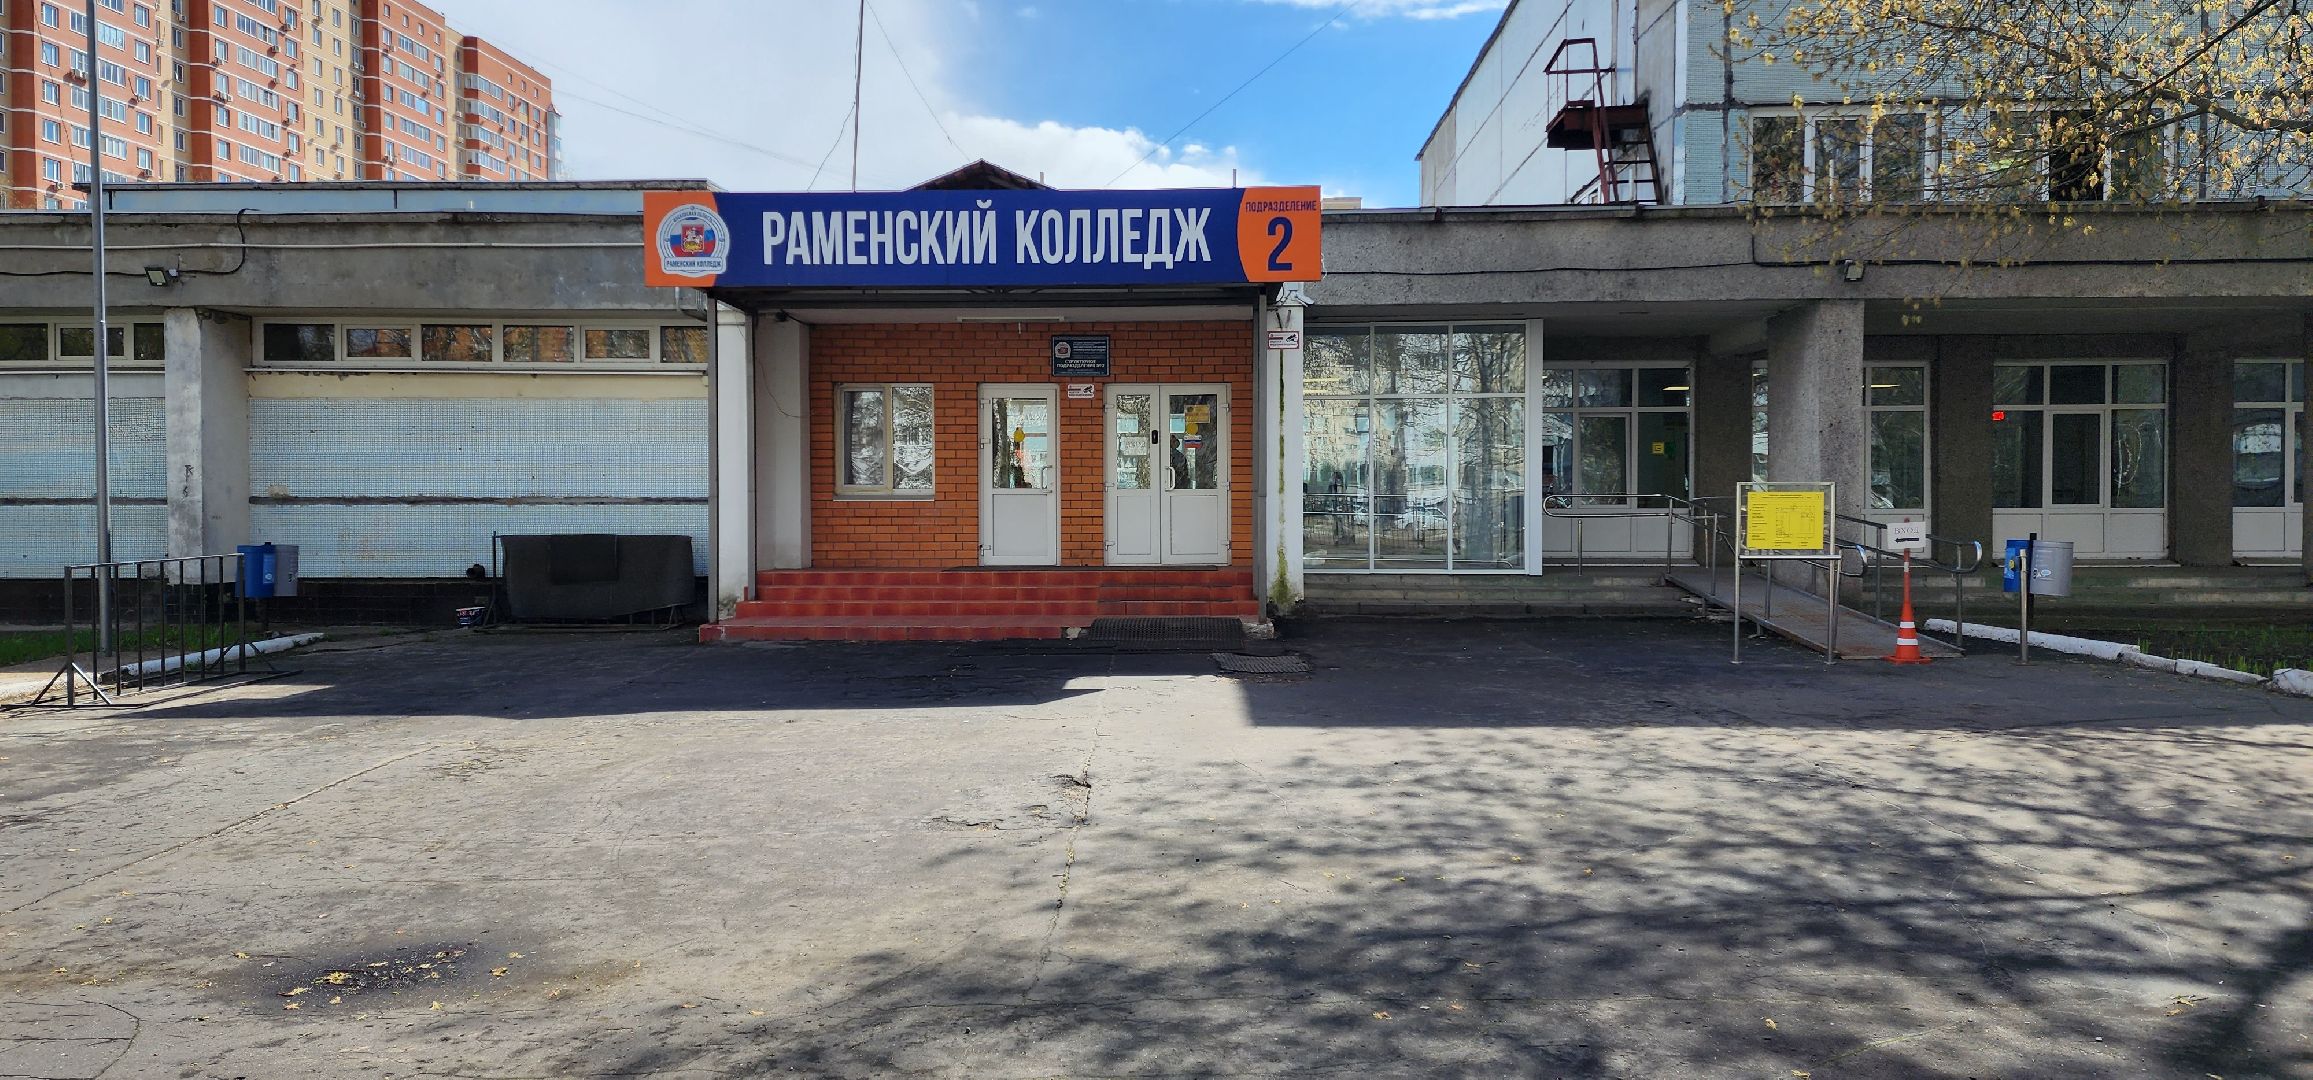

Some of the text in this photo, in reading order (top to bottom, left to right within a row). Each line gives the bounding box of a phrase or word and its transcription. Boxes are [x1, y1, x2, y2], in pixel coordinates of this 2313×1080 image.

[1246, 201, 1317, 212] ПОДРАЗДЕЛЕНИЕ
[762, 199, 1211, 270] РАМЕНСКИЙ КОЛЛЕДЖ
[1268, 217, 1293, 271] 2
[666, 260, 721, 268] РАМЕНСКИЙ КОЛЛЕДЖ
[1894, 527, 1920, 535] ВХОД
